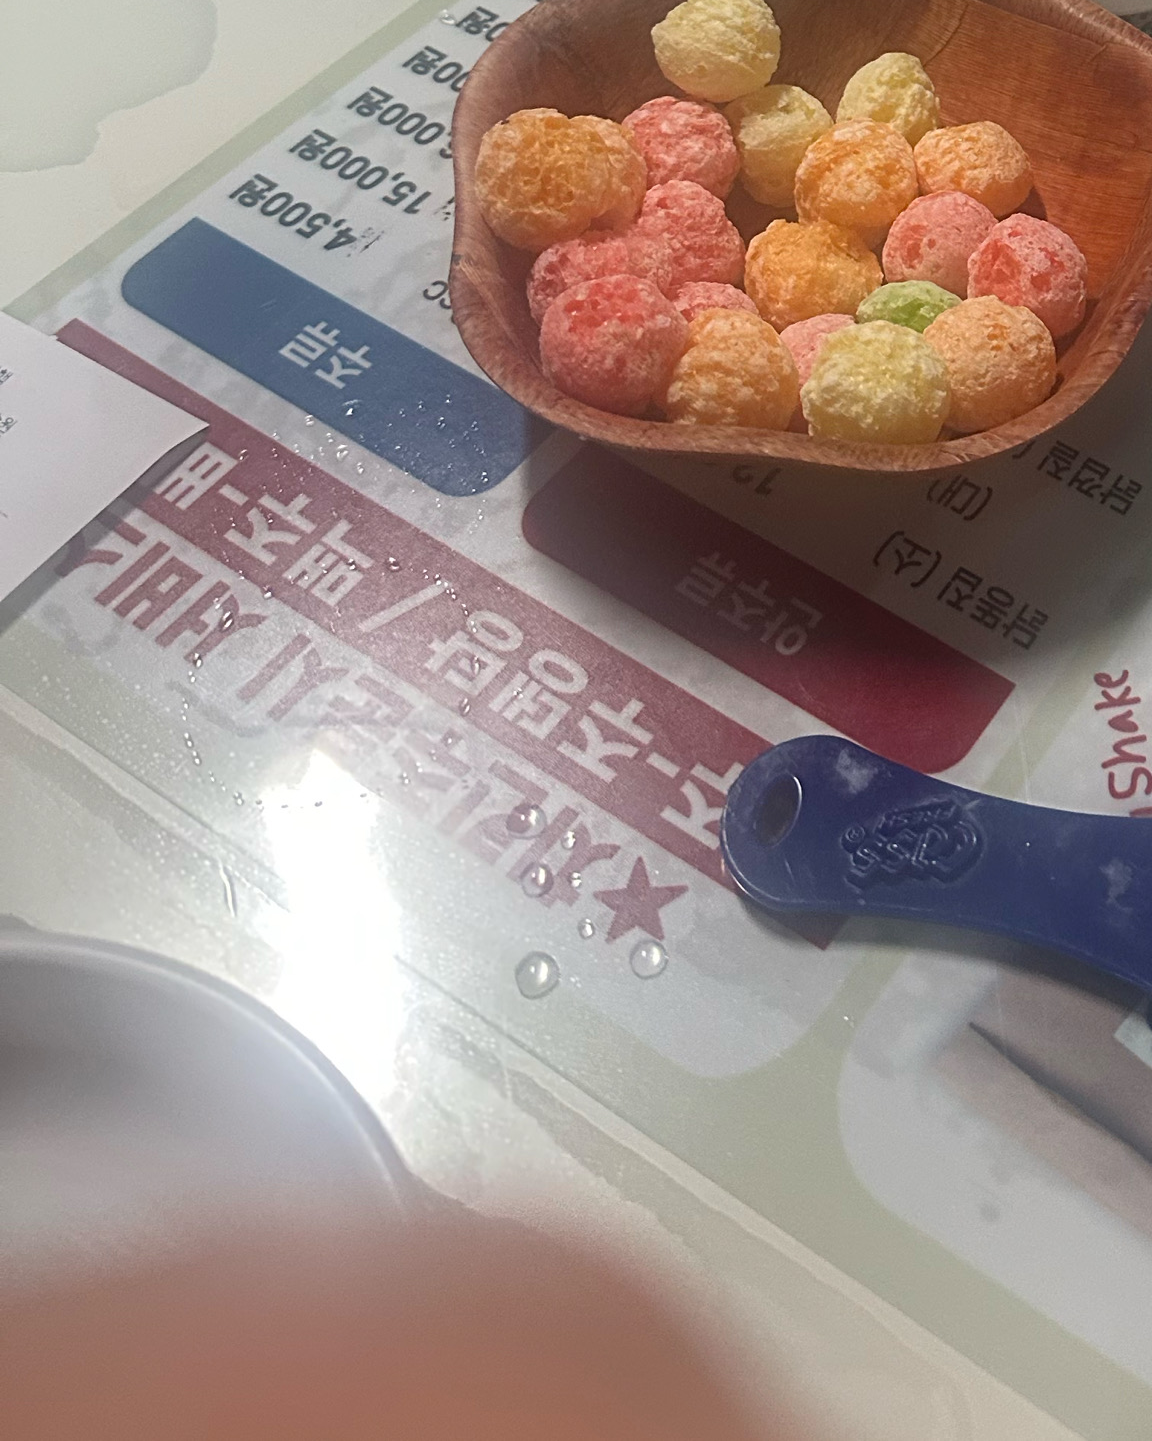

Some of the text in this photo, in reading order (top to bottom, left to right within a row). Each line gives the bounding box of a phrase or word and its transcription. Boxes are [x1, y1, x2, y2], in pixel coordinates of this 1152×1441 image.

[288, 129, 433, 216] 15,000원
[228, 173, 358, 253] 4,500원
[278, 320, 374, 390] 주류
